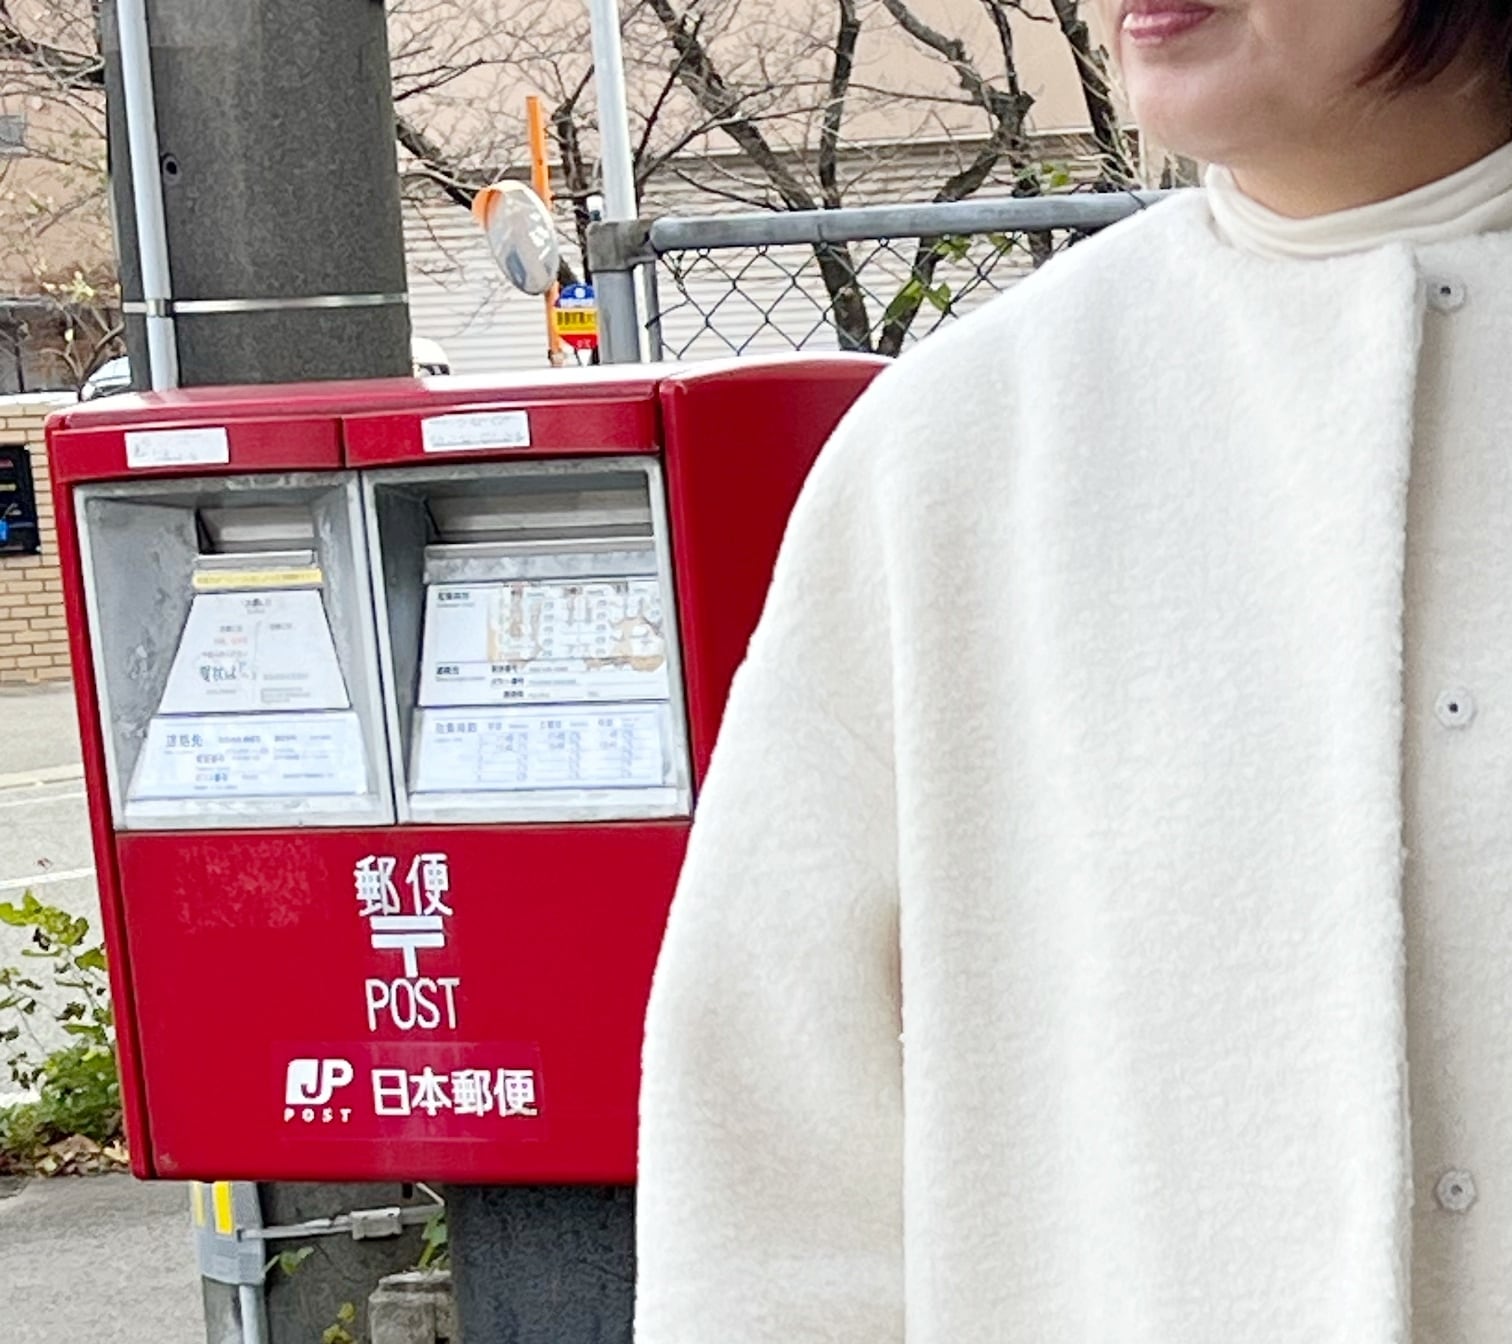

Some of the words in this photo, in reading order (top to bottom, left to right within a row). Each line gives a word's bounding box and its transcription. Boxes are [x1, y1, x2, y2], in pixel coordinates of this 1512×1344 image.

[354, 853, 453, 917] 郵便
[365, 977, 460, 1032] POST
[284, 1107, 352, 1123] POST
[371, 1066, 538, 1118] 日本郵便
